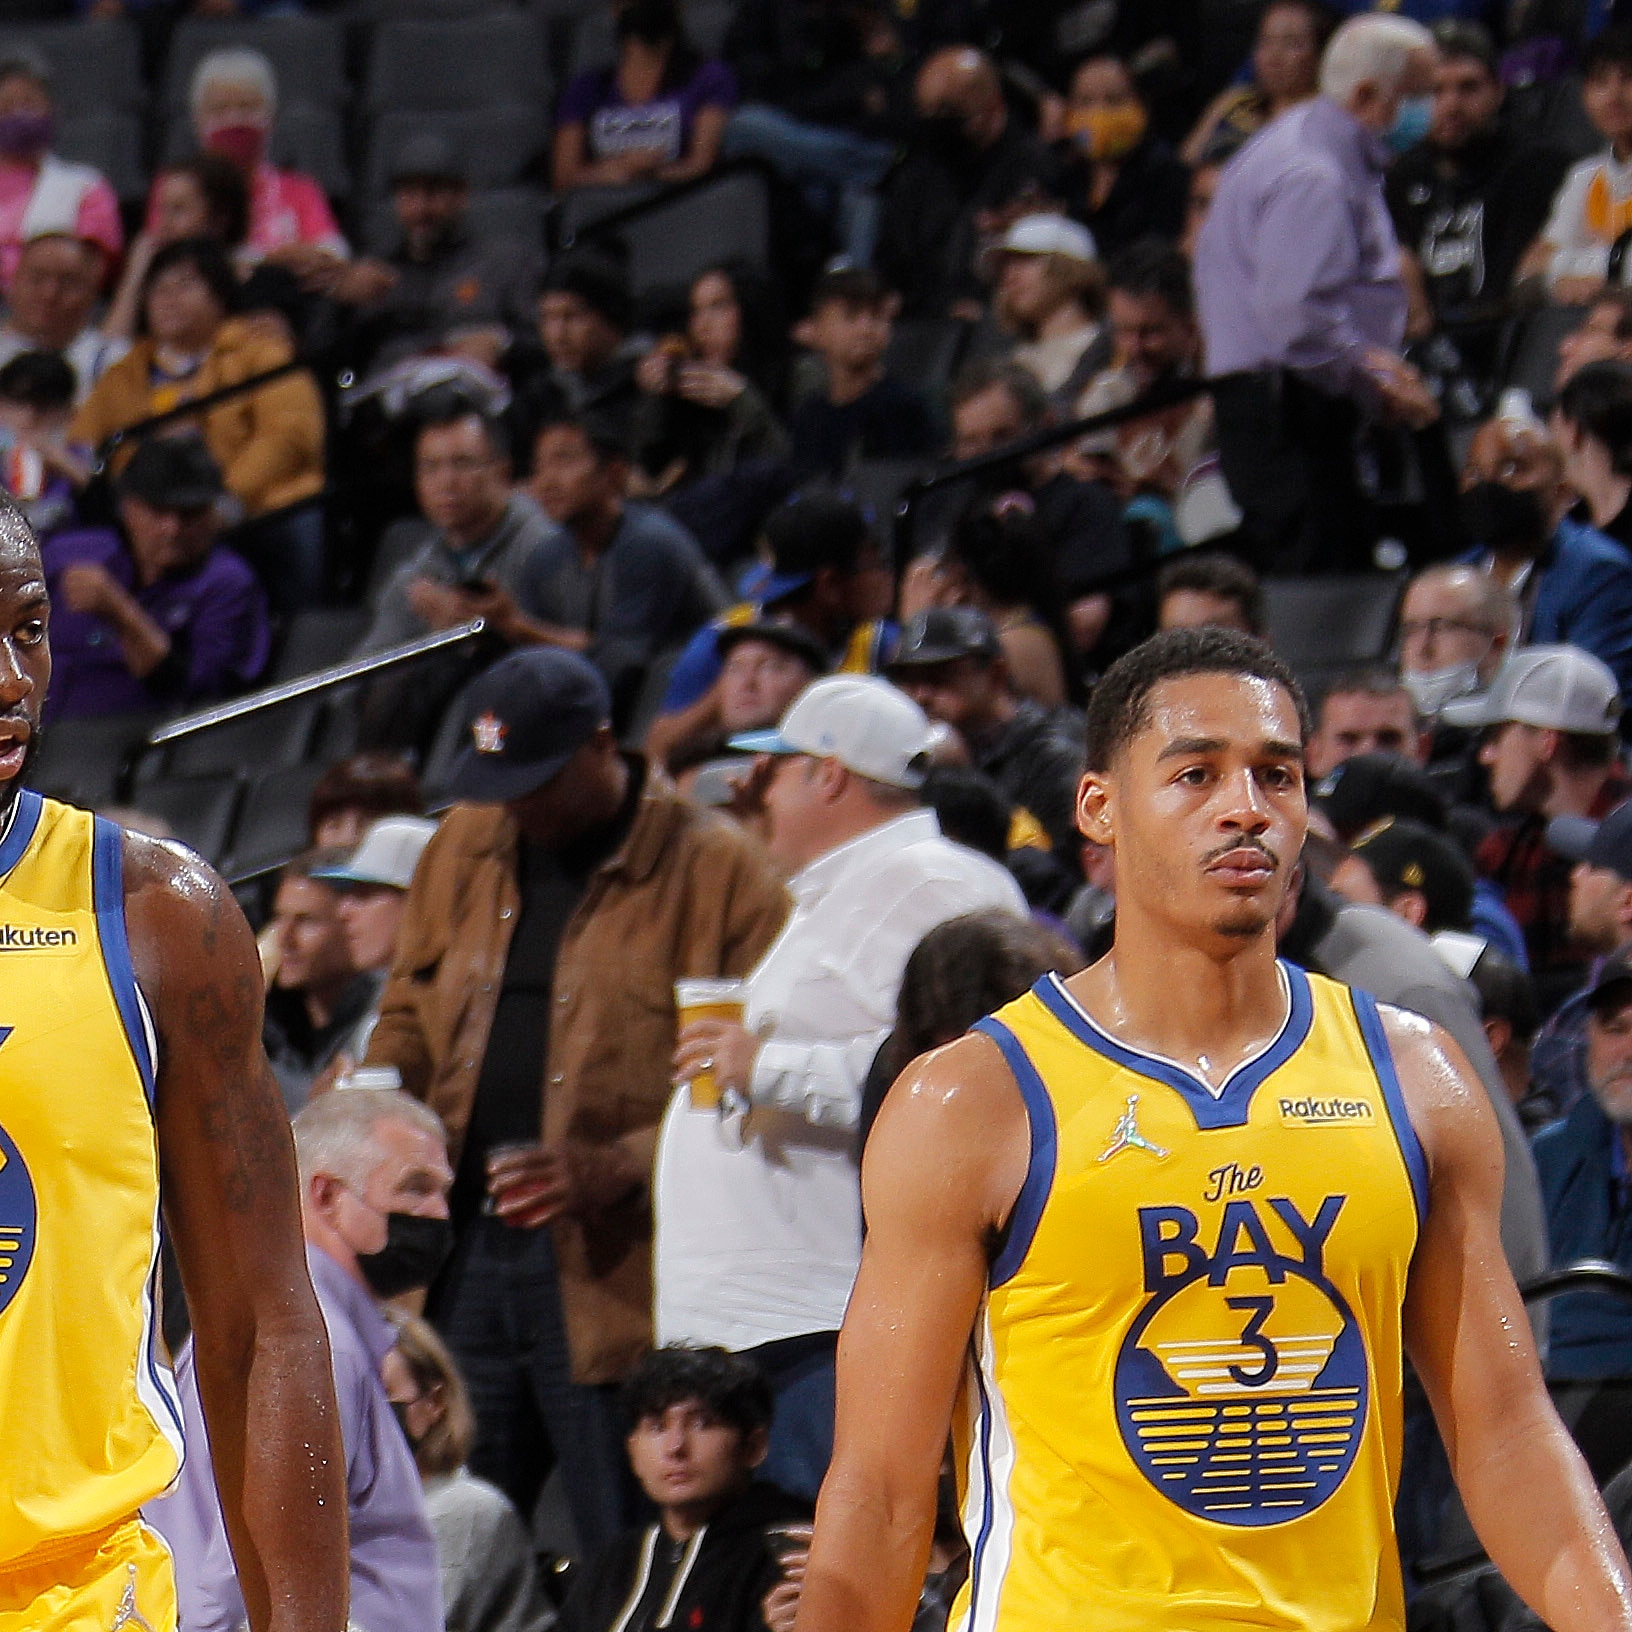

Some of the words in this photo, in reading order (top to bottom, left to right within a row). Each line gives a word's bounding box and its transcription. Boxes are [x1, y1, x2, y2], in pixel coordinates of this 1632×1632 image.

[1279, 1096, 1372, 1120] Rakuten
[1203, 1162, 1265, 1203] The
[1137, 1194, 1348, 1294] BAY
[1223, 1295, 1280, 1387] 3
